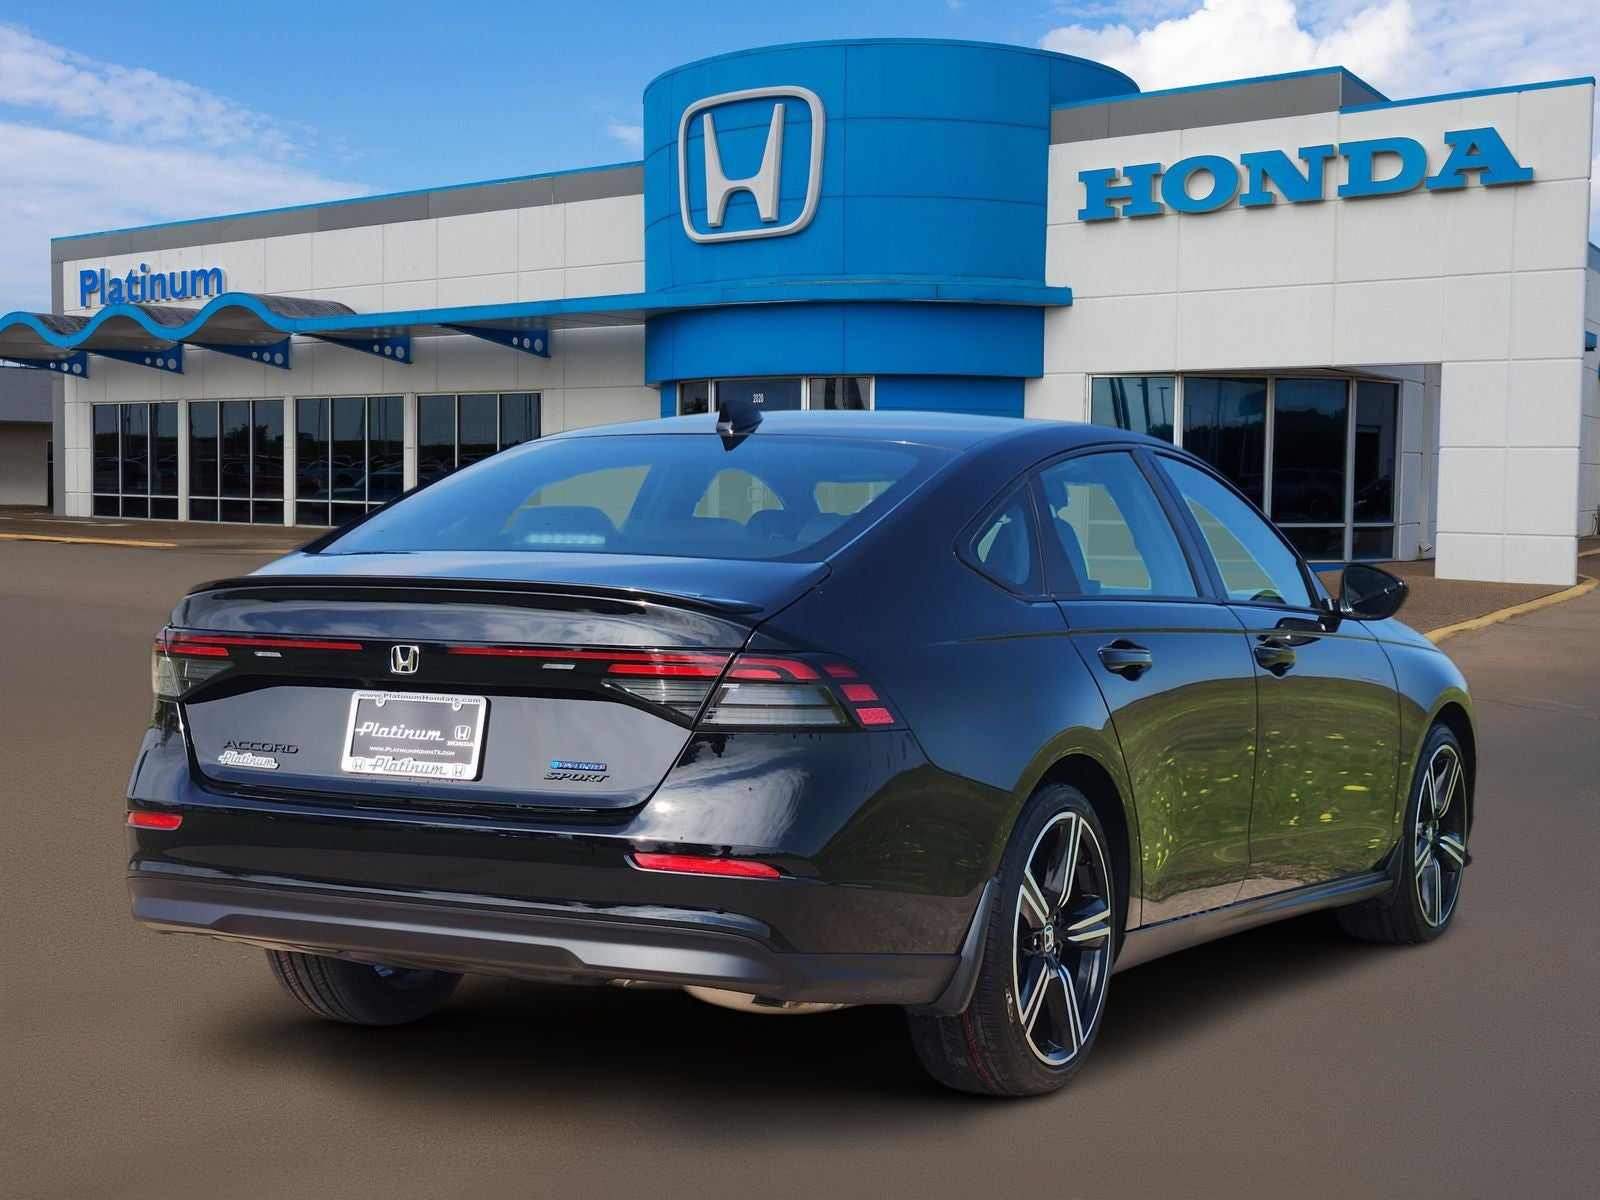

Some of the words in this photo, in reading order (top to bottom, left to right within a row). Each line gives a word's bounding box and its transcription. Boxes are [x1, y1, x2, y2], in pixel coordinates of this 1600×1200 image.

[1078, 126, 1534, 223] HONDA
[79, 263, 224, 308] Platinum
[355, 722, 444, 741] Platinum
[223, 739, 299, 754] ACCORD
[218, 751, 278, 769] Platinum
[369, 757, 448, 775] Platinum
[543, 772, 610, 783] SPORT
